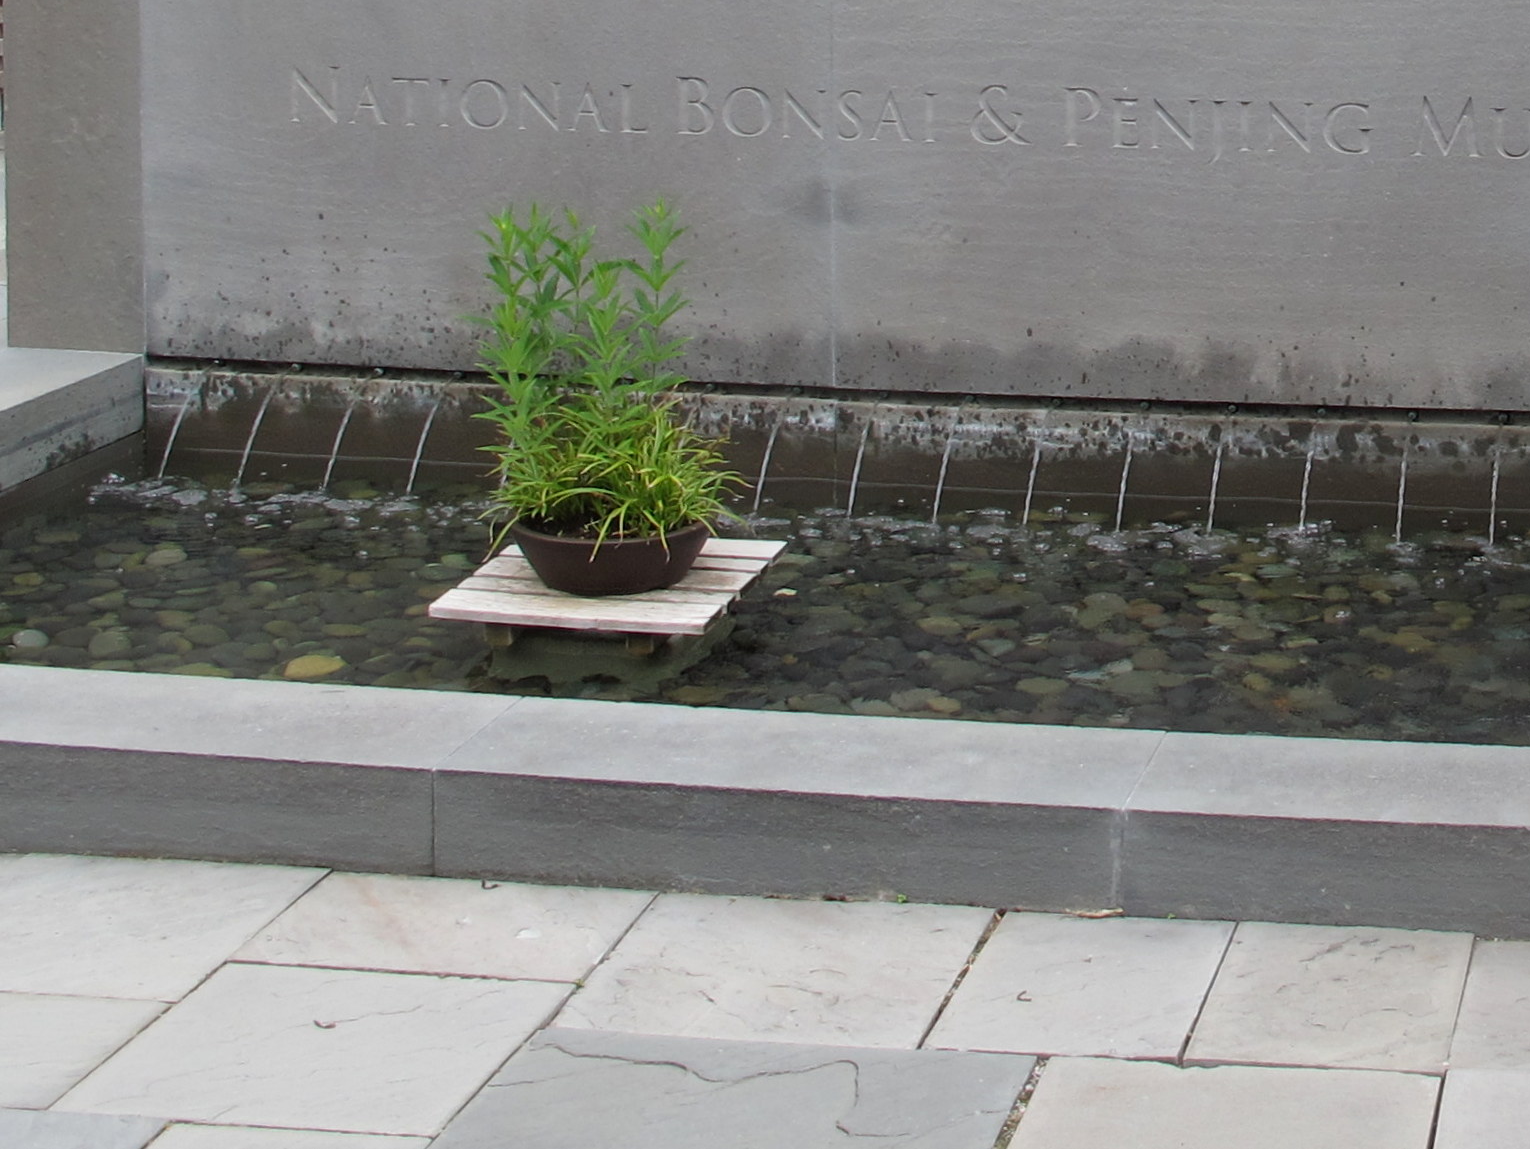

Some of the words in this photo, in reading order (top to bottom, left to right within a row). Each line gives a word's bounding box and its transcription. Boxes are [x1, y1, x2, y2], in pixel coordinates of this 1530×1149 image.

[290, 65, 649, 135] NATIONAL
[675, 75, 939, 145] BONSAI
[970, 83, 1033, 147] &
[1062, 86, 1375, 164] PENJING
